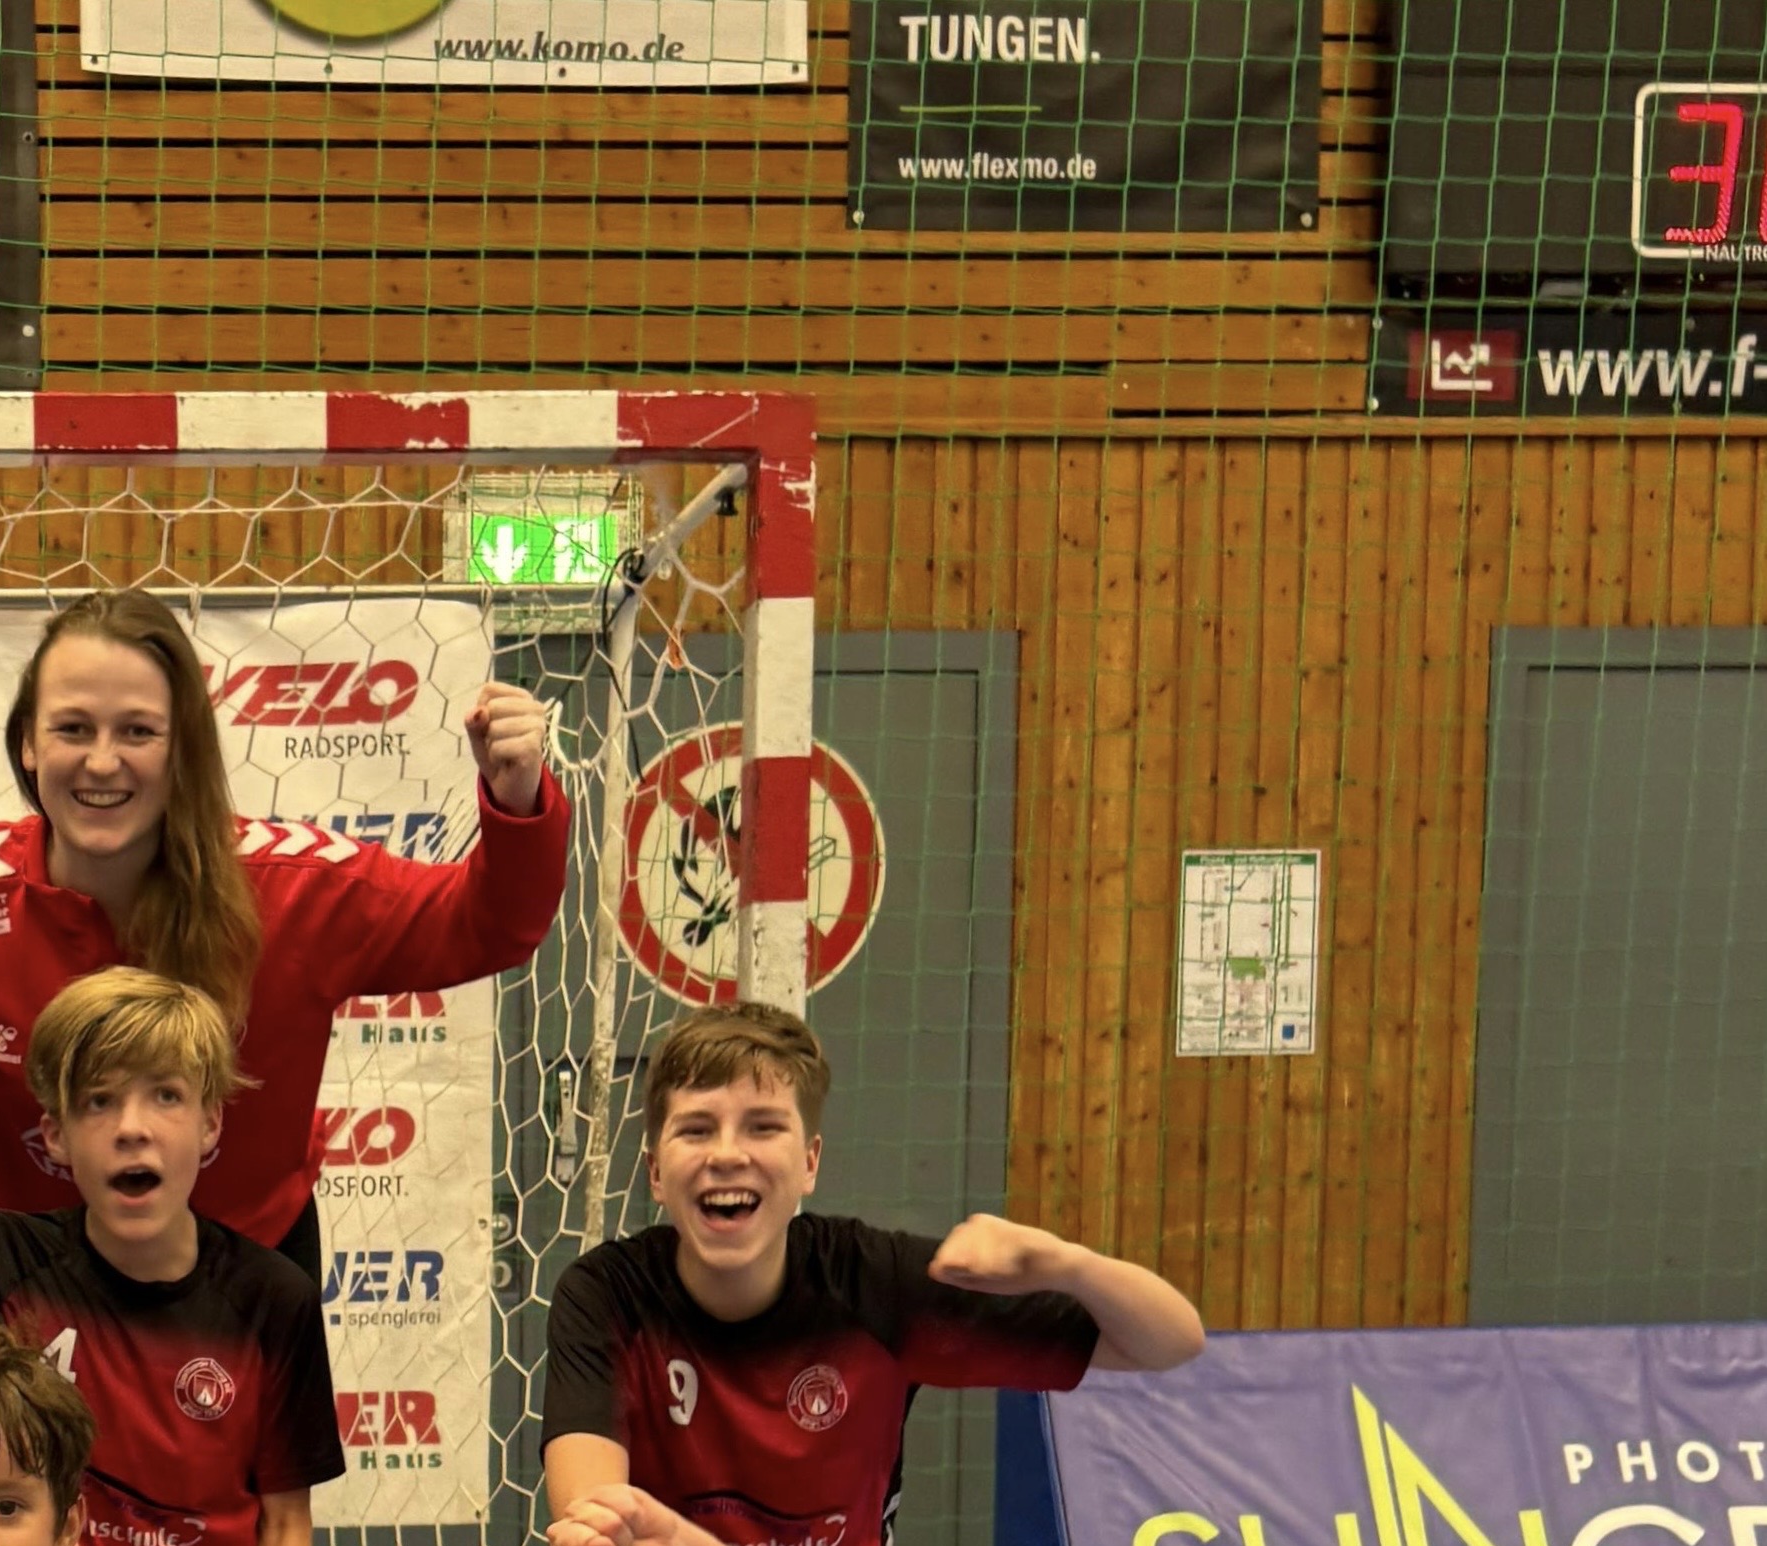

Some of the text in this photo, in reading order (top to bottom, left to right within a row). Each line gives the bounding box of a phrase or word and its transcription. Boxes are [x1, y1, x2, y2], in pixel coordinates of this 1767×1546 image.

[434, 31, 685, 63] www.komo.de
[899, 14, 1101, 63] TUNGEN.
[898, 152, 1097, 180] www.flexmo.de
[361, 1023, 447, 1044] Haus
[347, 1308, 443, 1329] spenglerei
[38, 1327, 78, 1384] 4
[667, 1359, 699, 1426] 9
[359, 1450, 444, 1470] Haus
